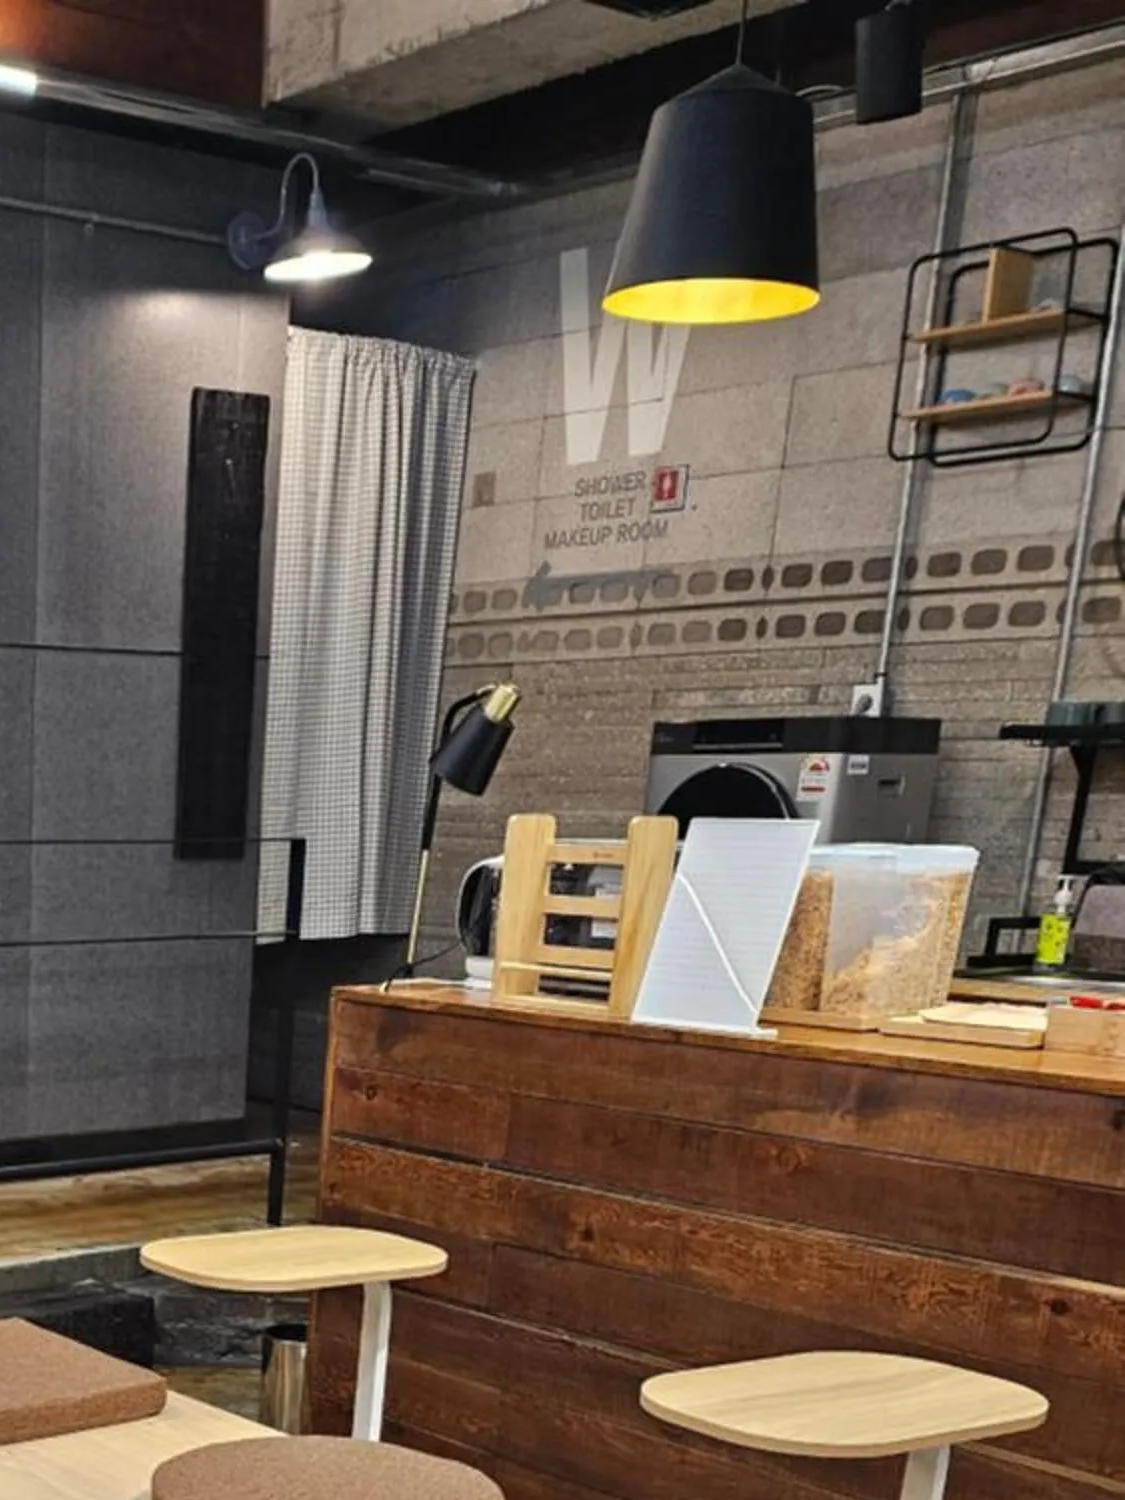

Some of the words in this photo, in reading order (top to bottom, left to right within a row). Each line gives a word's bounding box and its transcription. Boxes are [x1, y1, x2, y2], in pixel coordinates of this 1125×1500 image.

[560, 248, 692, 465] W
[574, 469, 648, 497] SHOWER
[580, 498, 637, 523] TOILET
[544, 526, 613, 549] MAKEUP
[616, 519, 670, 543] ROOM
